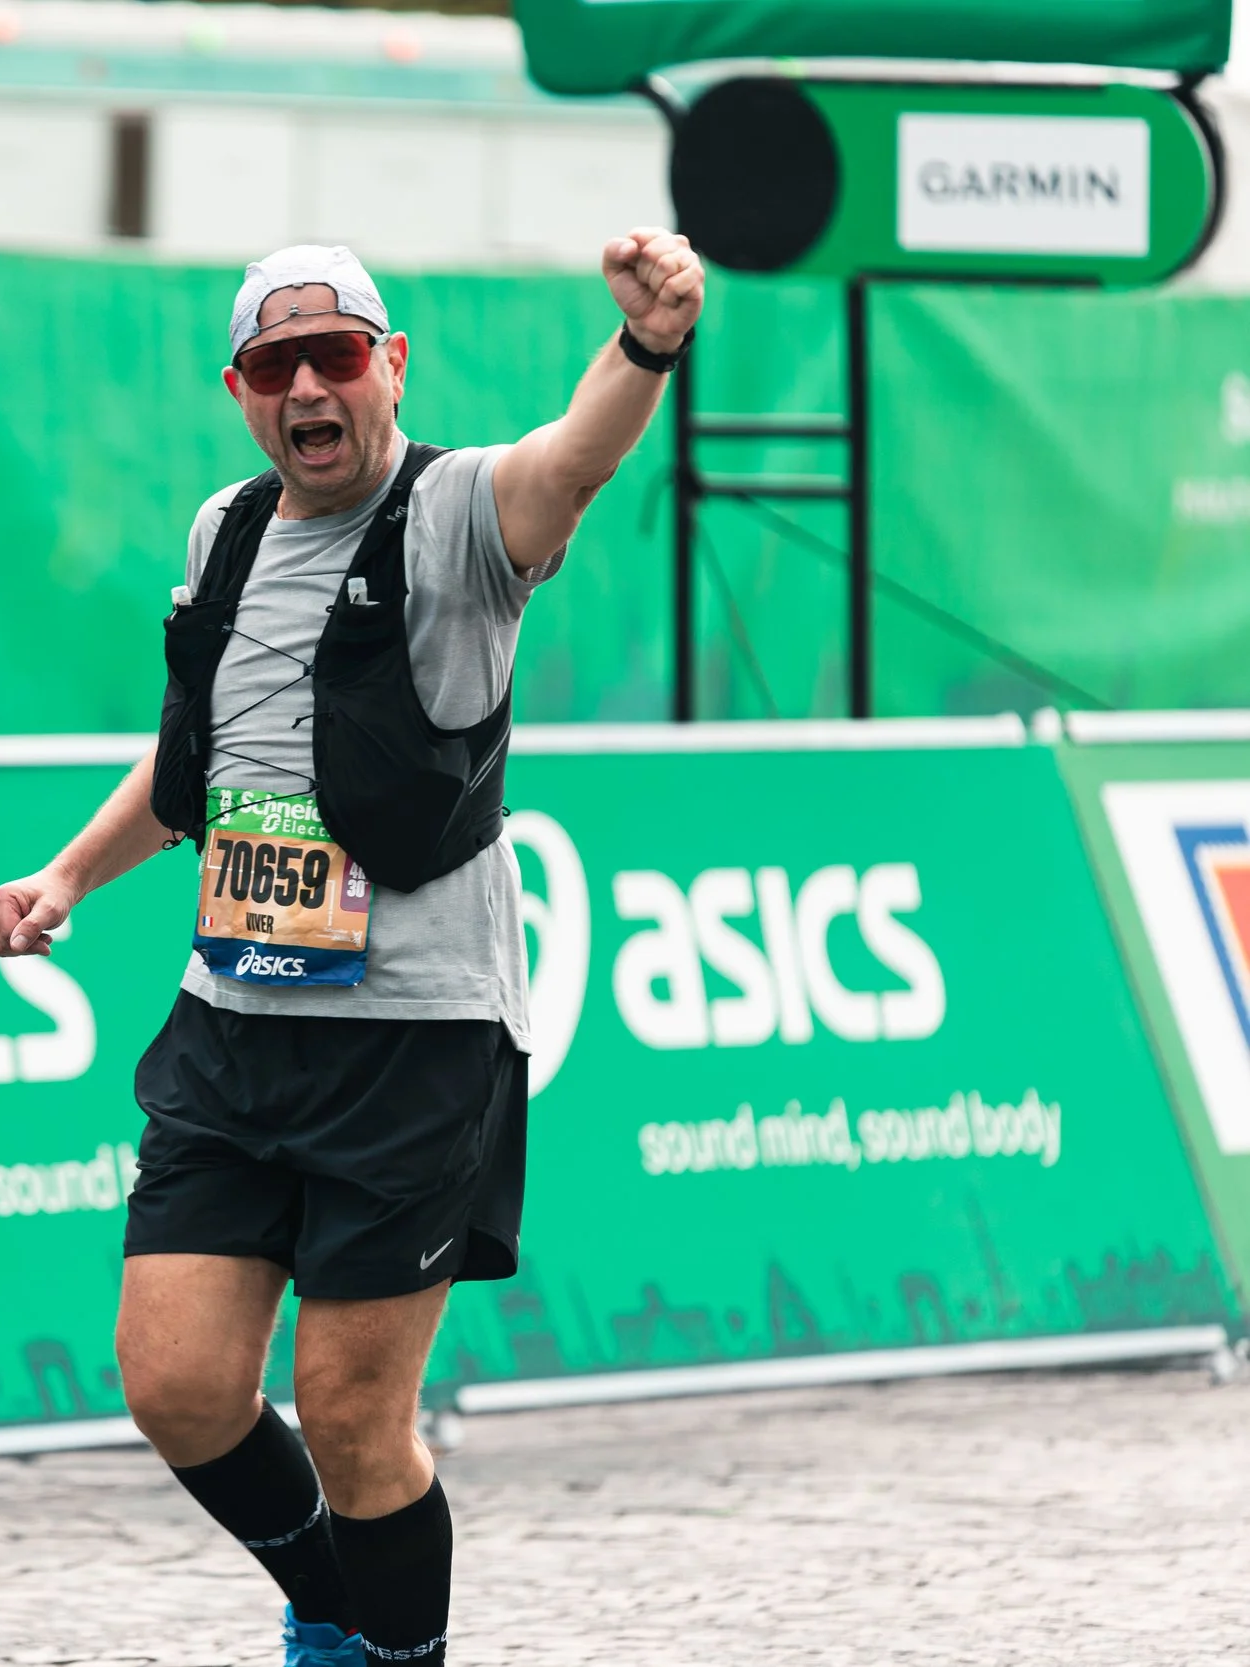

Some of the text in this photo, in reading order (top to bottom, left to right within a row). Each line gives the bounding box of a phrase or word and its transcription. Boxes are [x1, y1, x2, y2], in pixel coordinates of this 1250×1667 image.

[917, 158, 1121, 207] GARMIN
[213, 838, 331, 910] 70659
[246, 912, 274, 934] VIVER
[611, 862, 947, 1050] asics
[638, 1101, 758, 1175] sound
[857, 1090, 971, 1162] sound
[965, 1086, 1061, 1167] body
